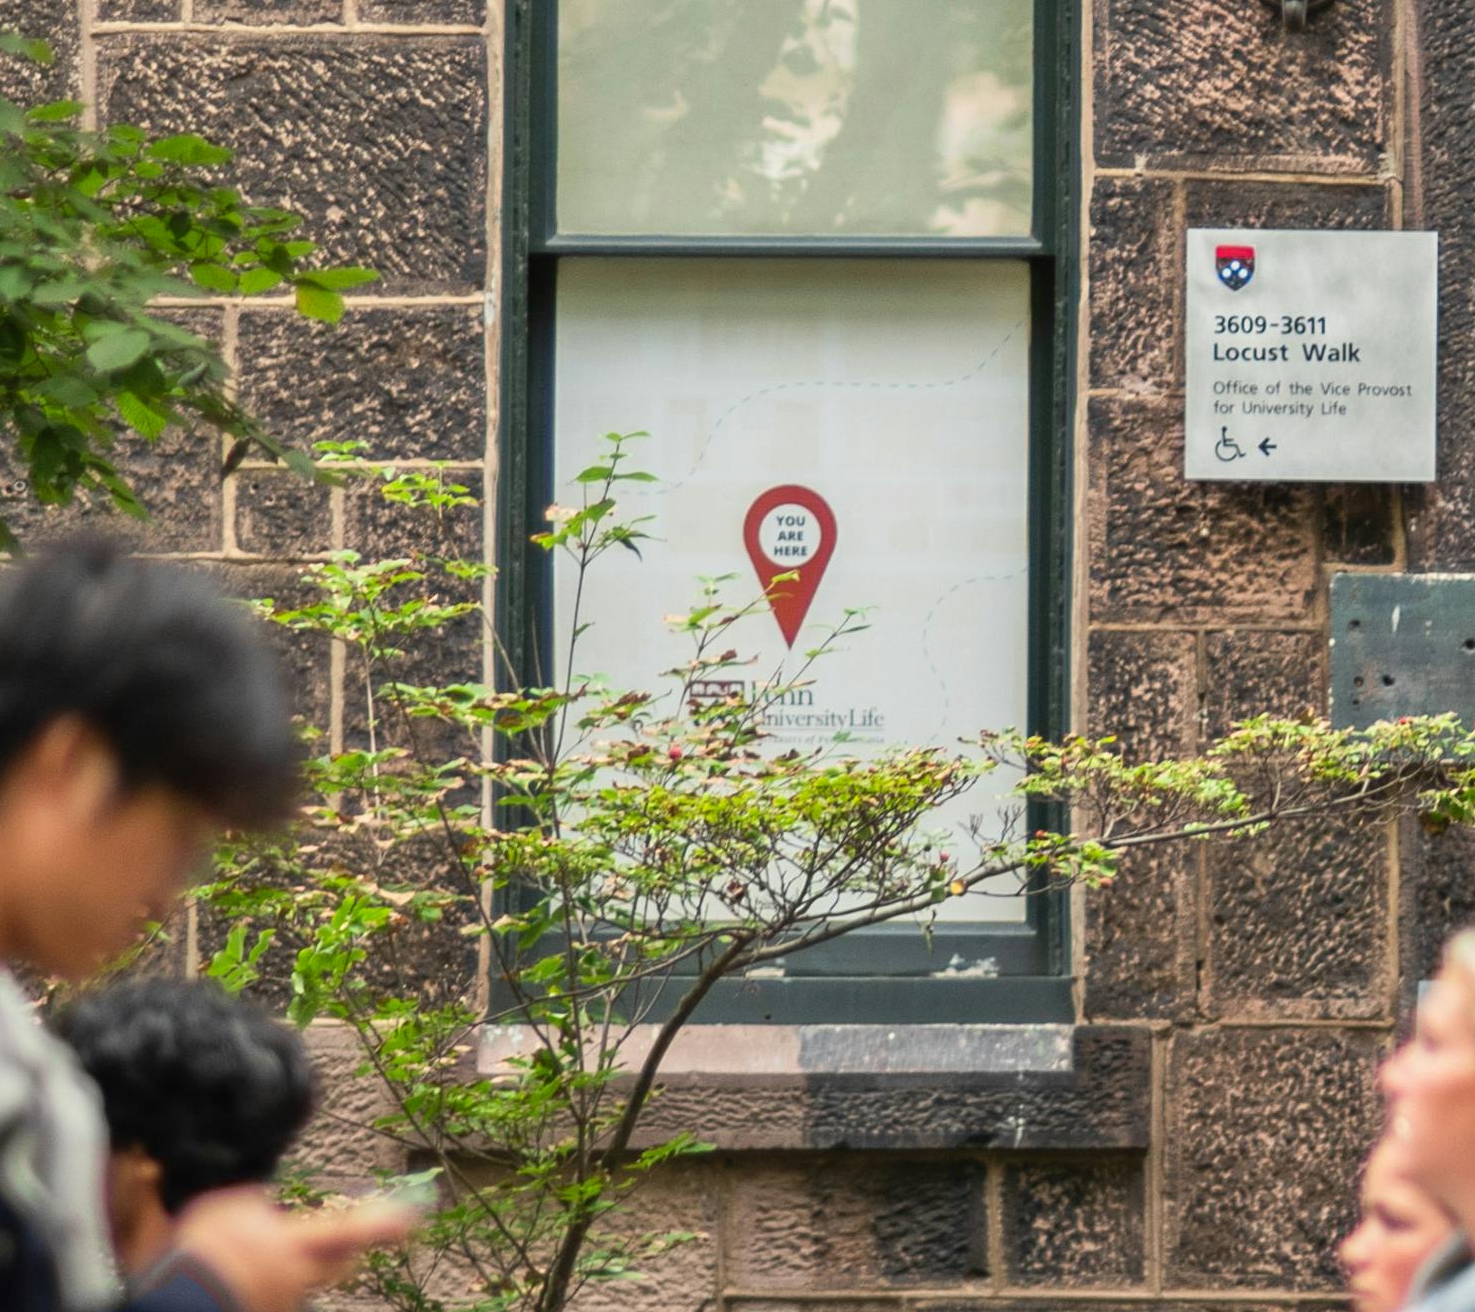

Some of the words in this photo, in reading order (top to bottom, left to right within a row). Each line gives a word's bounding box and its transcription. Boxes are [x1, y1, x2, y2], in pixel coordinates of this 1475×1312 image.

[1214, 315, 1326, 335] 3609-3611
[1213, 343, 1289, 362] Locust
[1302, 343, 1361, 363] Walk
[1213, 381, 1258, 395] Office
[1265, 382, 1281, 395] of
[1289, 382, 1313, 396] the
[1320, 382, 1351, 396] Vice
[1358, 383, 1412, 397] Provost
[1214, 401, 1234, 414] for
[1242, 402, 1313, 418] University
[1321, 402, 1347, 416] Life
[776, 515, 806, 527] YOU
[778, 530, 804, 542] ARE
[774, 545, 808, 557] HERE
